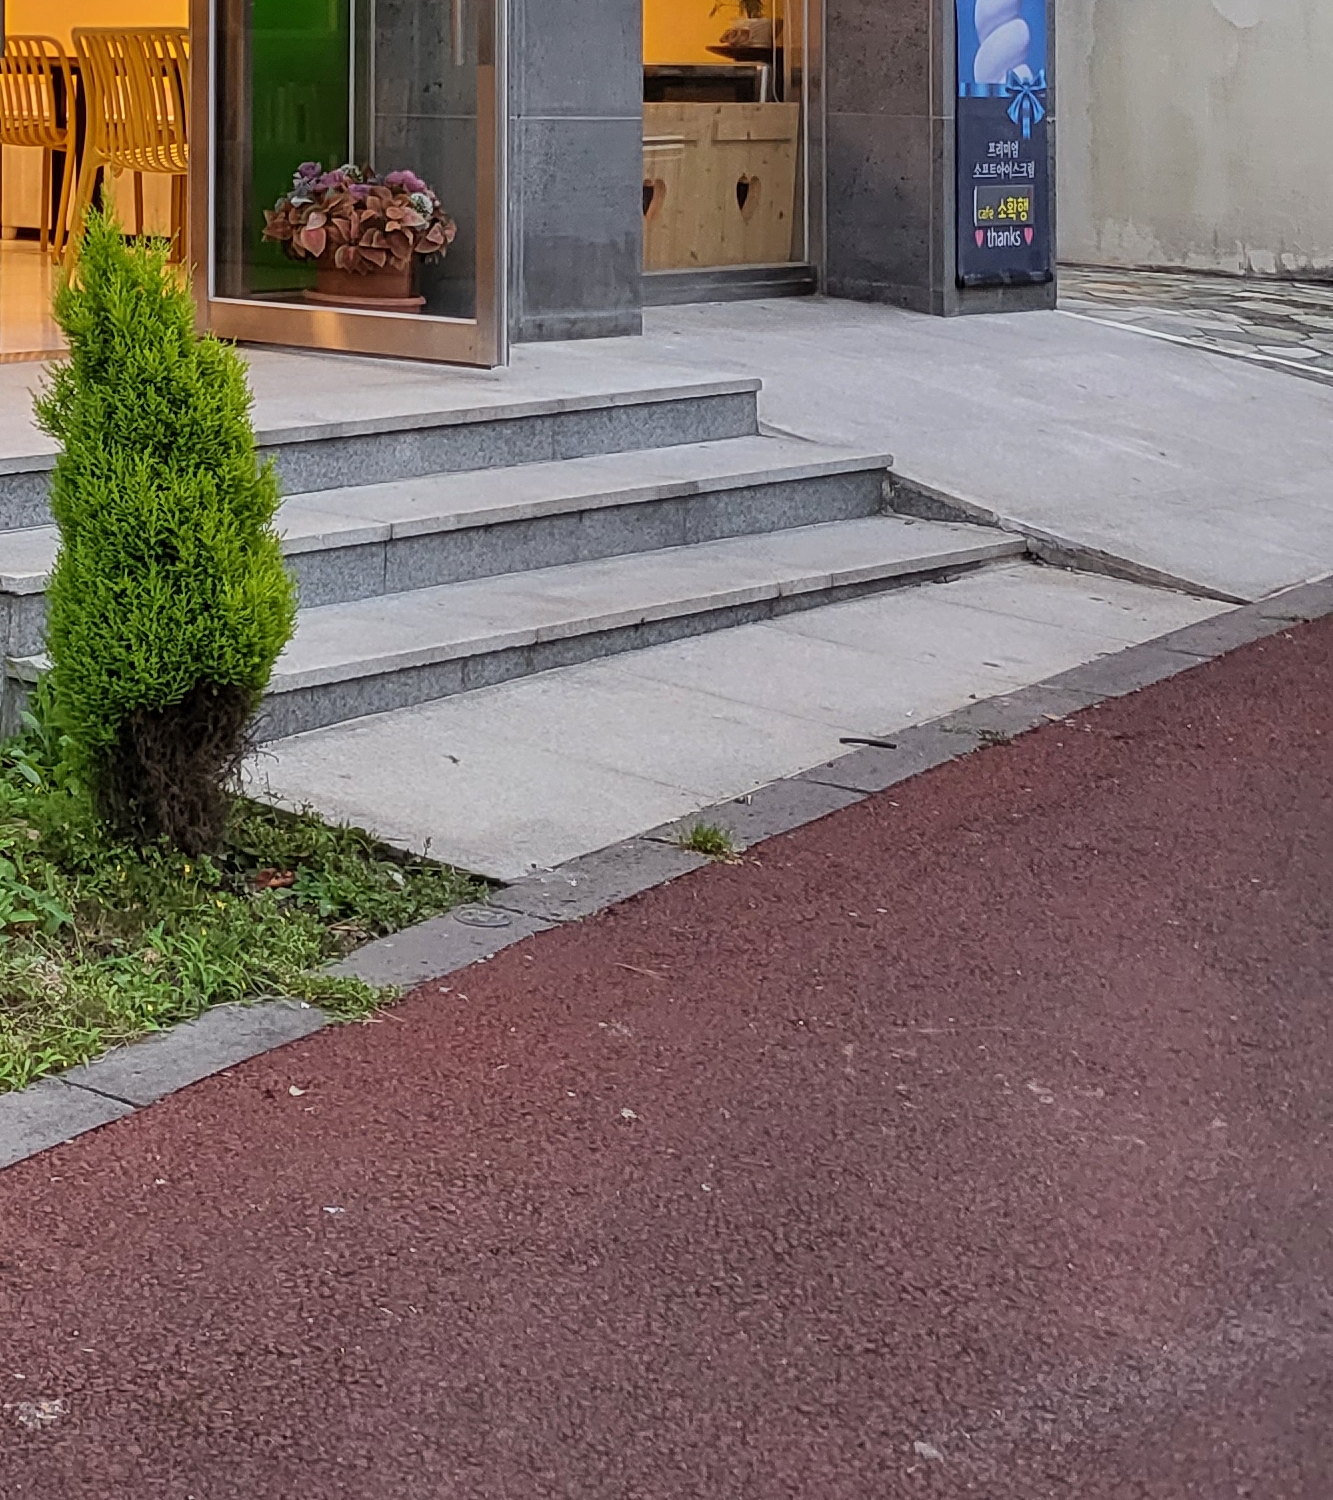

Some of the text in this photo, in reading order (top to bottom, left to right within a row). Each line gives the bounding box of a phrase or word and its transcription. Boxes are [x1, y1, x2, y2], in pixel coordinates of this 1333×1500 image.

[986, 140, 1019, 159] 프리미엄
[972, 160, 1035, 180] 소프트아이스크림
[978, 196, 1030, 221] cafe 소확행
[986, 226, 1021, 248] thanks
